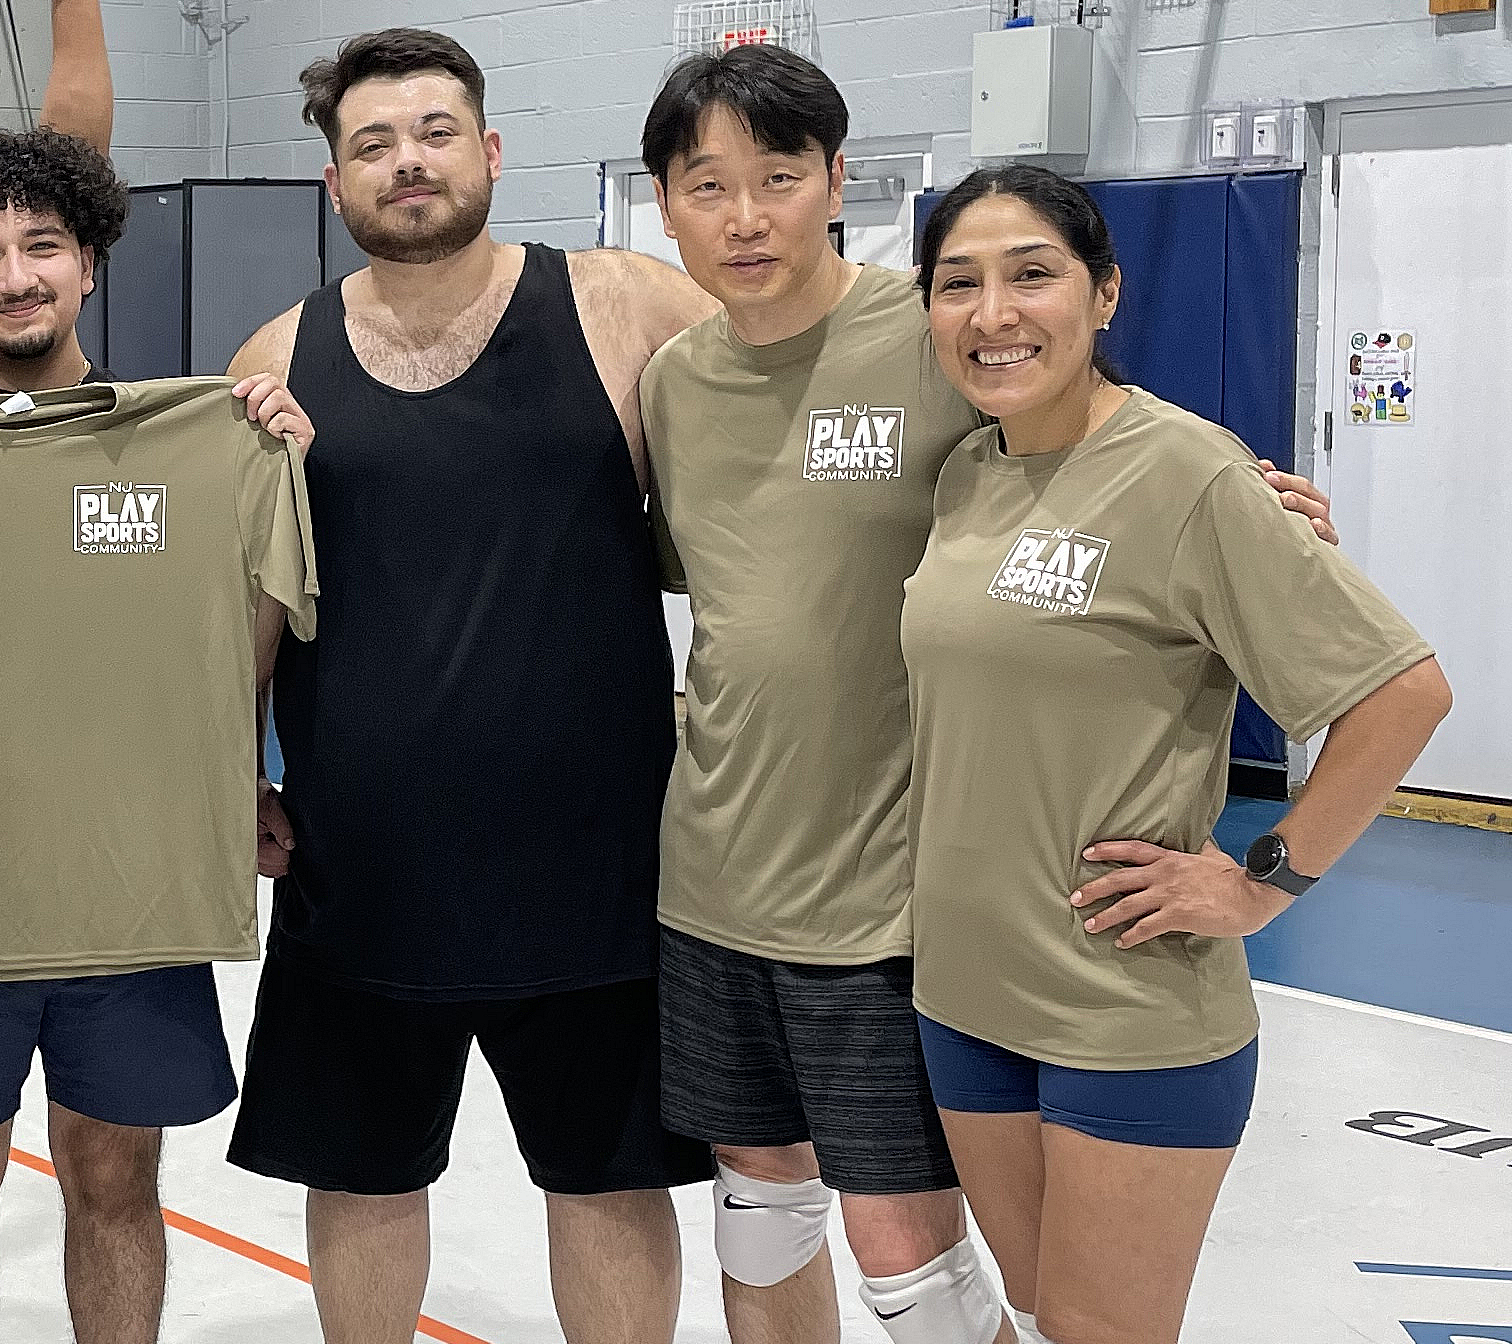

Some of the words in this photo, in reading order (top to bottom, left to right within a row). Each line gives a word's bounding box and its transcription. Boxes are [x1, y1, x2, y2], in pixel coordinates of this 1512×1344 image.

[843, 403, 868, 416] NJ
[811, 415, 898, 449] PLAY
[809, 446, 895, 470] SPORTS
[808, 470, 893, 481] COMMUNITY
[108, 481, 133, 493] NJ
[79, 492, 160, 523] PLAY
[79, 522, 160, 543] SPORTS
[1051, 528, 1075, 539] NJ
[79, 544, 159, 554] COMMUNITY
[1007, 536, 1101, 580] PLAY
[997, 566, 1088, 605] SPORTS
[991, 588, 1081, 616] COMMUNITY
